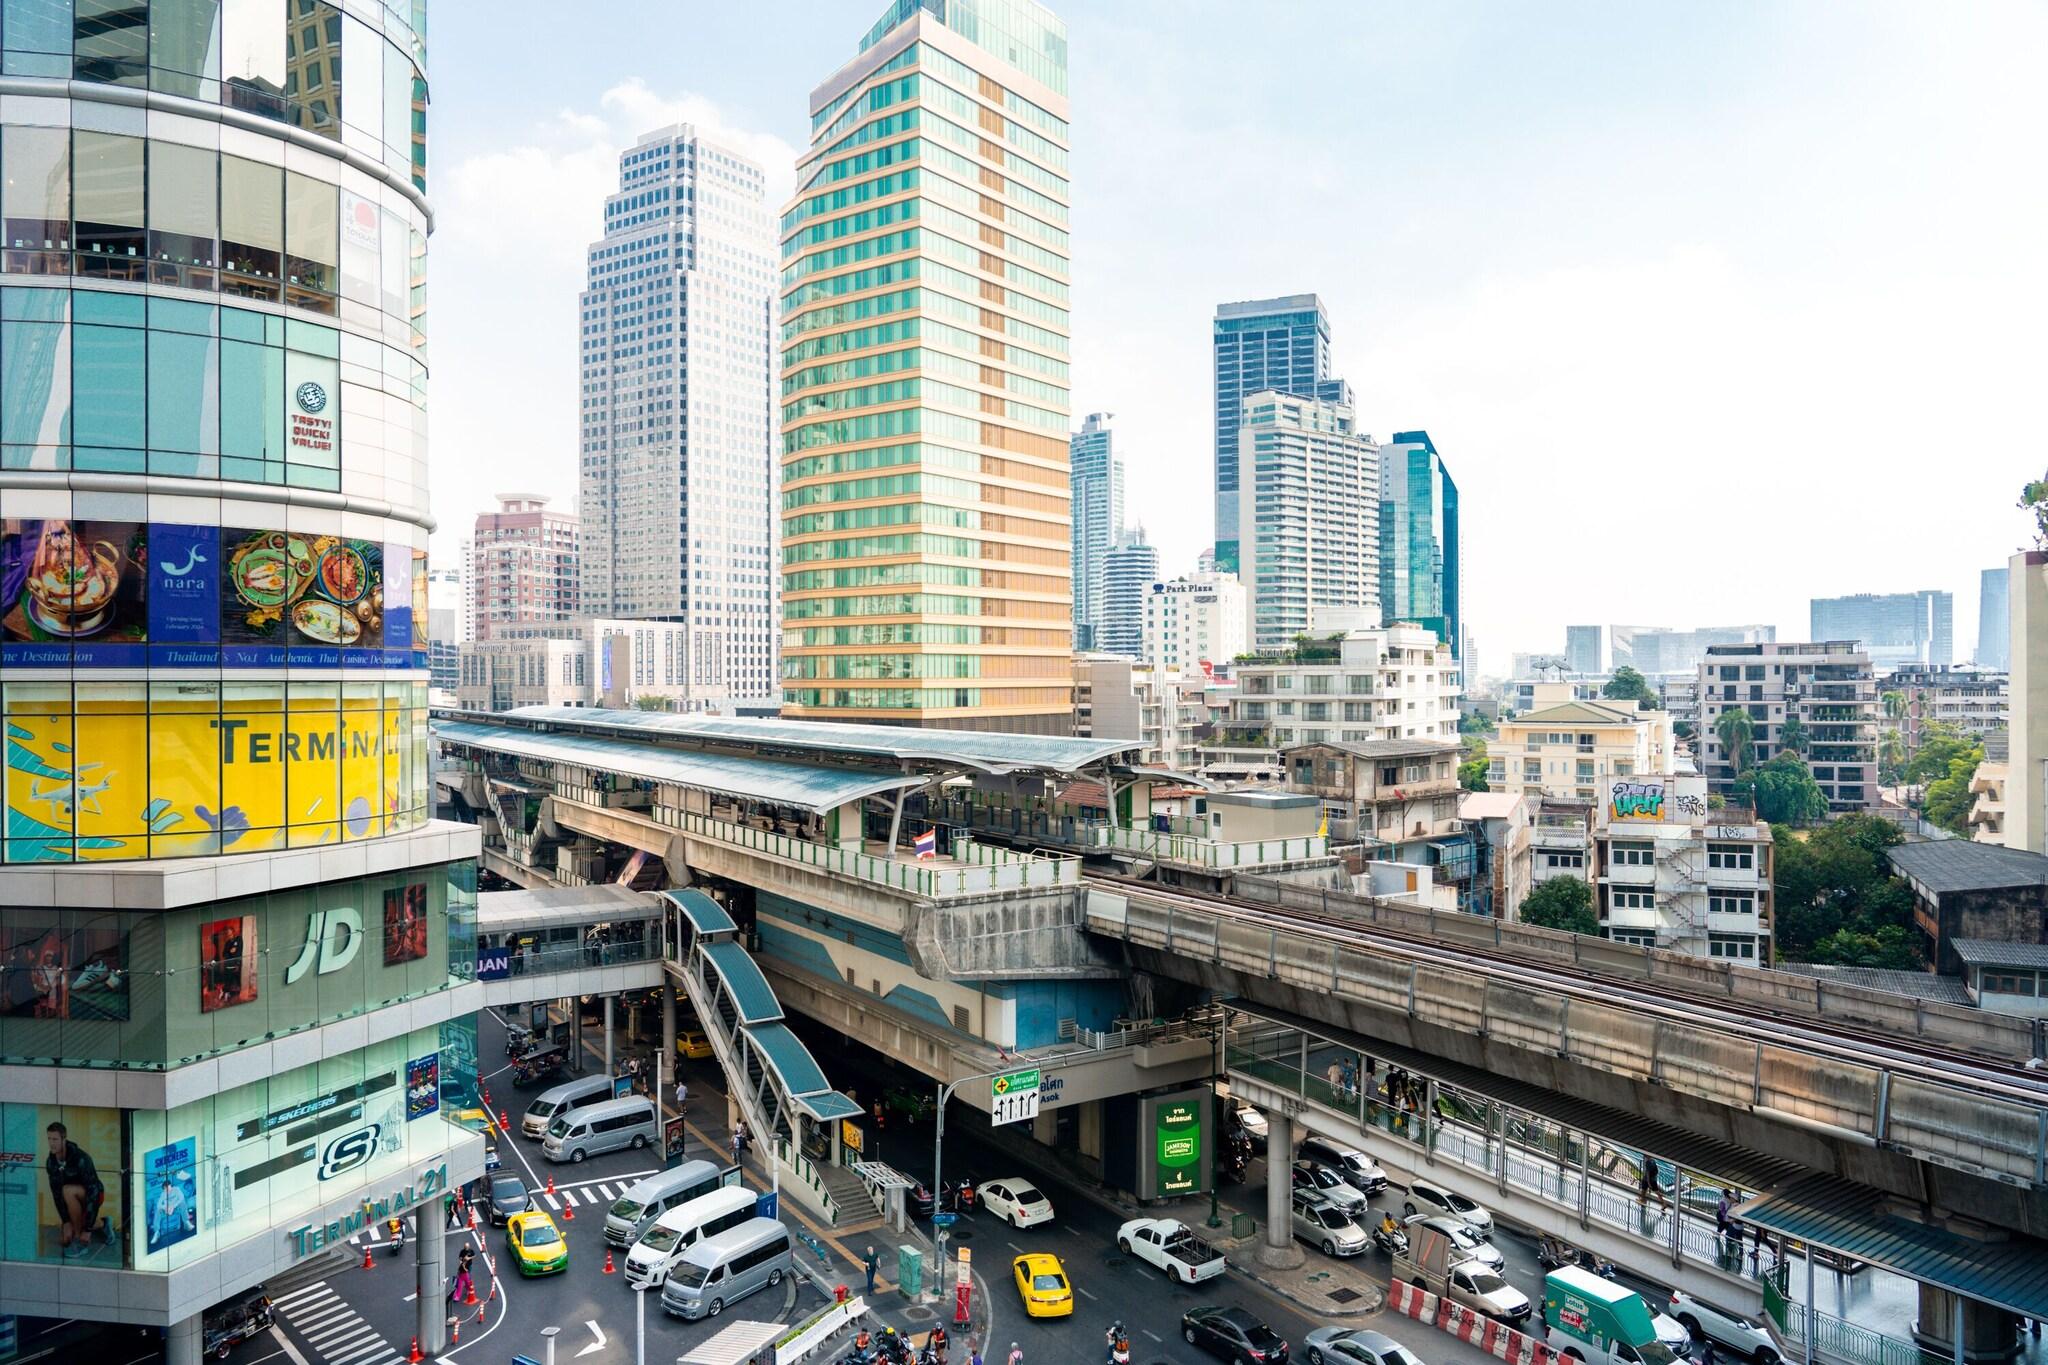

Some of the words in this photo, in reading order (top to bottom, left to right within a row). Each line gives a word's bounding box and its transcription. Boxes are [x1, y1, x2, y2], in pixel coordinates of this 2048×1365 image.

[292, 415, 331, 429] TASTY!
[293, 426, 330, 439] QUICK!
[292, 437, 331, 451] VALUE!
[164, 579, 205, 589] nara
[1166, 585, 1187, 593] Park
[1188, 584, 1213, 593] Plaza
[22, 651, 93, 662] Destination
[266, 653, 313, 664] Authentic
[318, 653, 338, 664] Thai
[342, 654, 369, 665] Cuisine
[285, 907, 363, 985] JD
[477, 957, 508, 973] JAN
[1040, 1075, 1064, 1092] อโศก
[1040, 1093, 1060, 1104] Asok
[277, 1095, 338, 1123] SKECHERS
[1166, 1142, 1191, 1152] JAMESON
[155, 1148, 188, 1168] SKECHERS
[424, 1162, 447, 1197] 21
